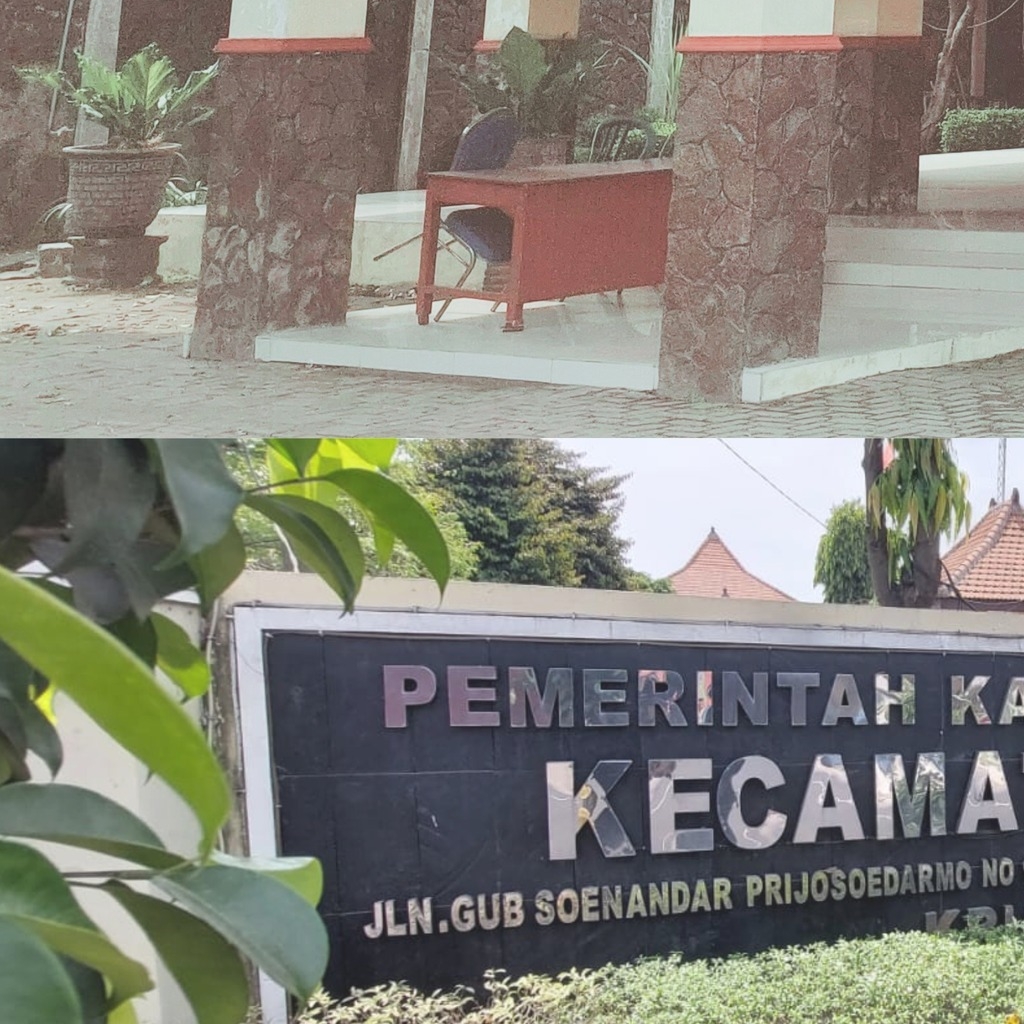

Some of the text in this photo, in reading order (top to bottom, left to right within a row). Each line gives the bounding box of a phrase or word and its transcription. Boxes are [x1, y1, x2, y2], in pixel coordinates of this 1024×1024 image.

[383, 665, 916, 727] PEMERINTAH
[534, 877, 733, 926] SOENANDAR
[746, 861, 972, 907] PRIJOSOEDARMO
[982, 857, 1014, 888] NO
